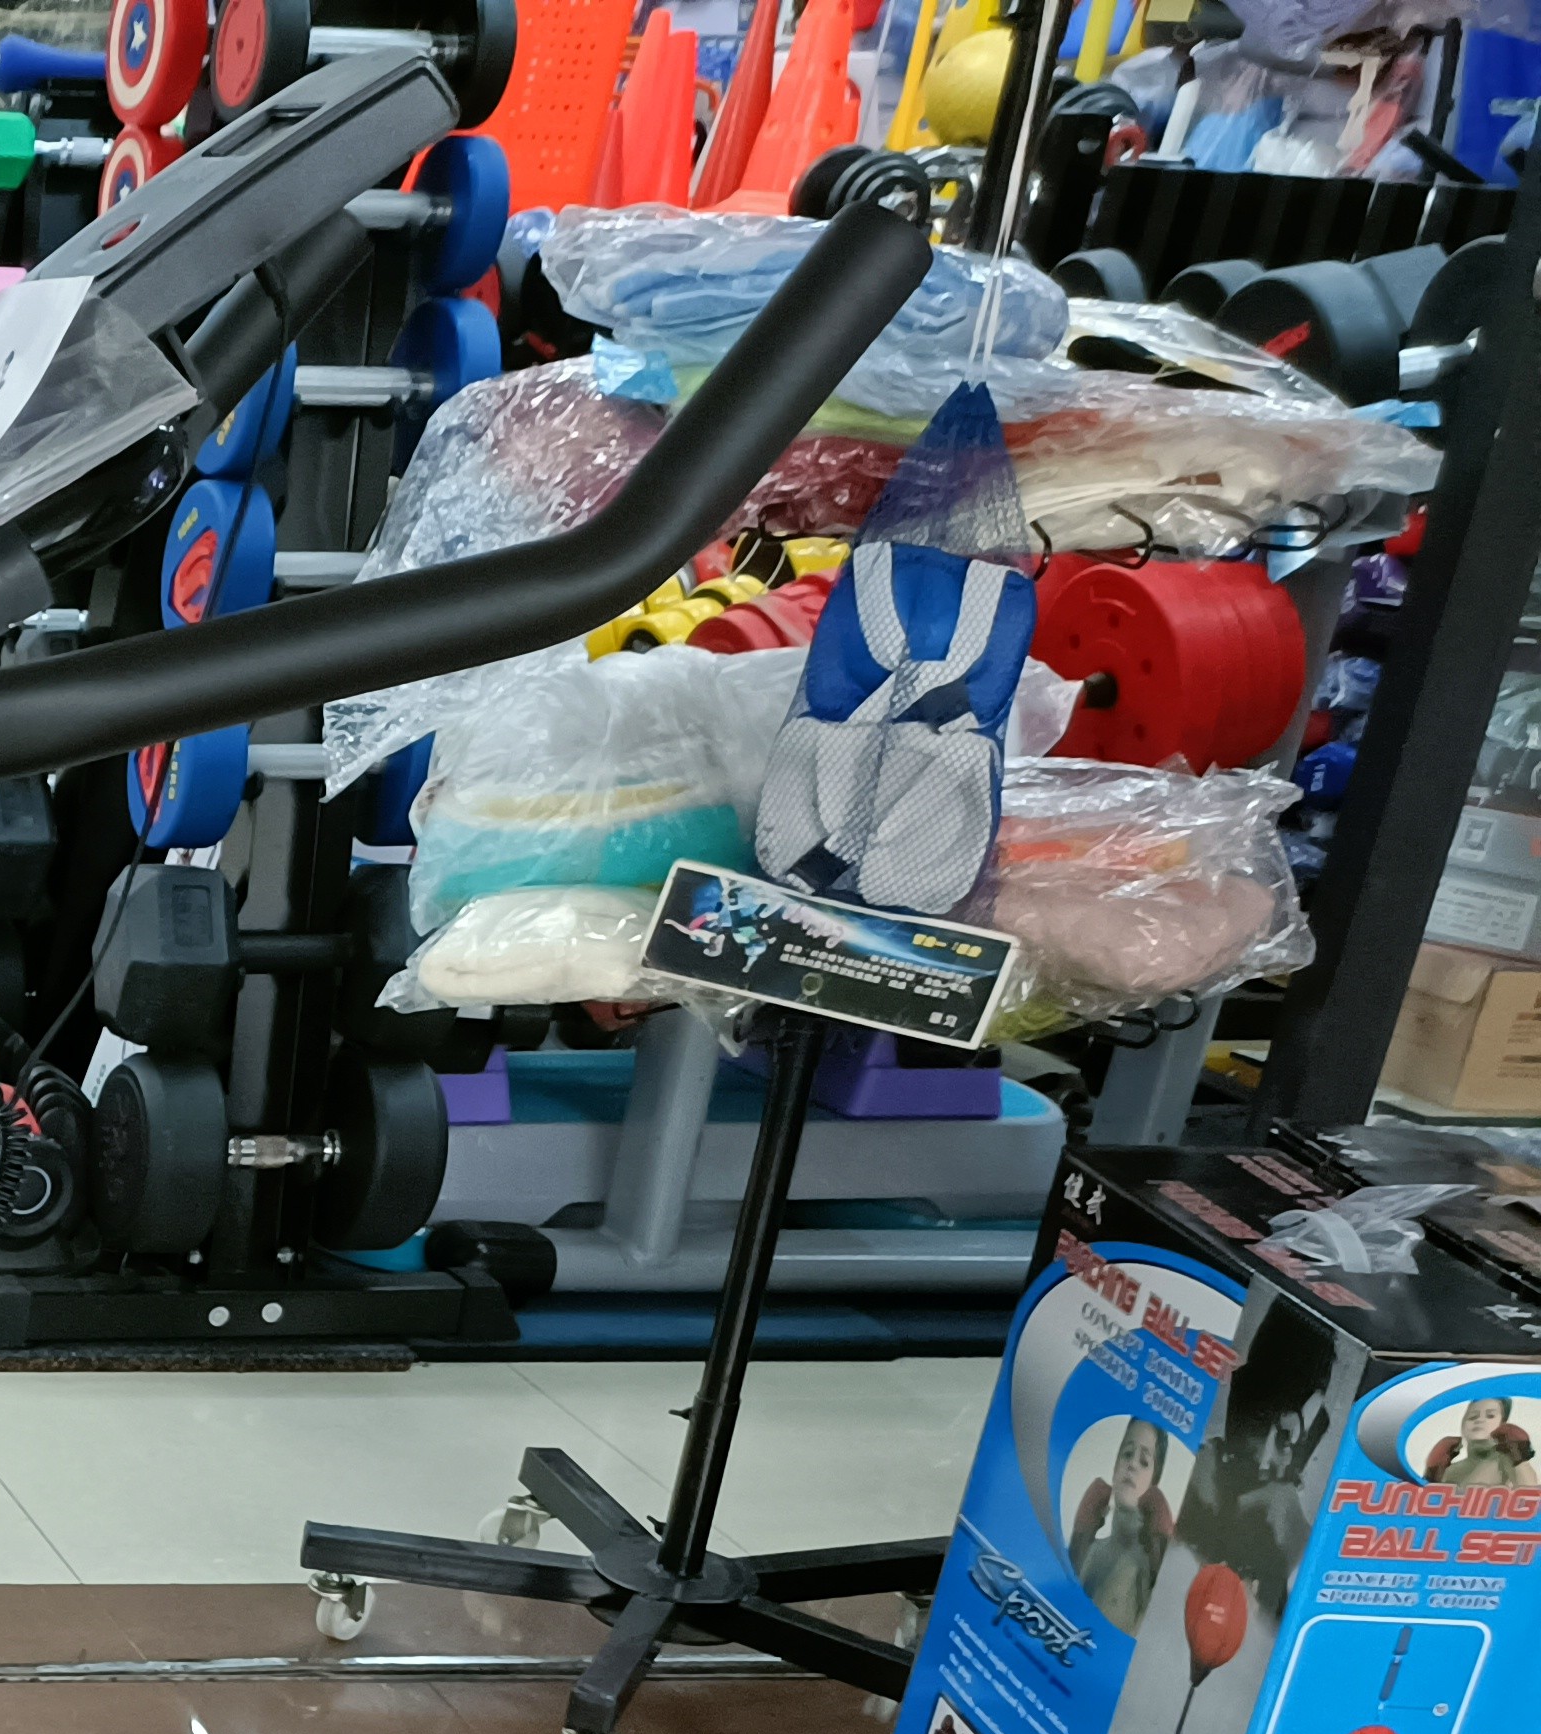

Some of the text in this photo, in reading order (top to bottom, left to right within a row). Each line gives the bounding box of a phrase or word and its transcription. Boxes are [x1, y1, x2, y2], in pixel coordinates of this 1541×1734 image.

[1141, 1290, 1191, 1358] BALL
[1329, 1479, 1541, 1520] PUNCHING
[1338, 1524, 1541, 1565] BALL SET
